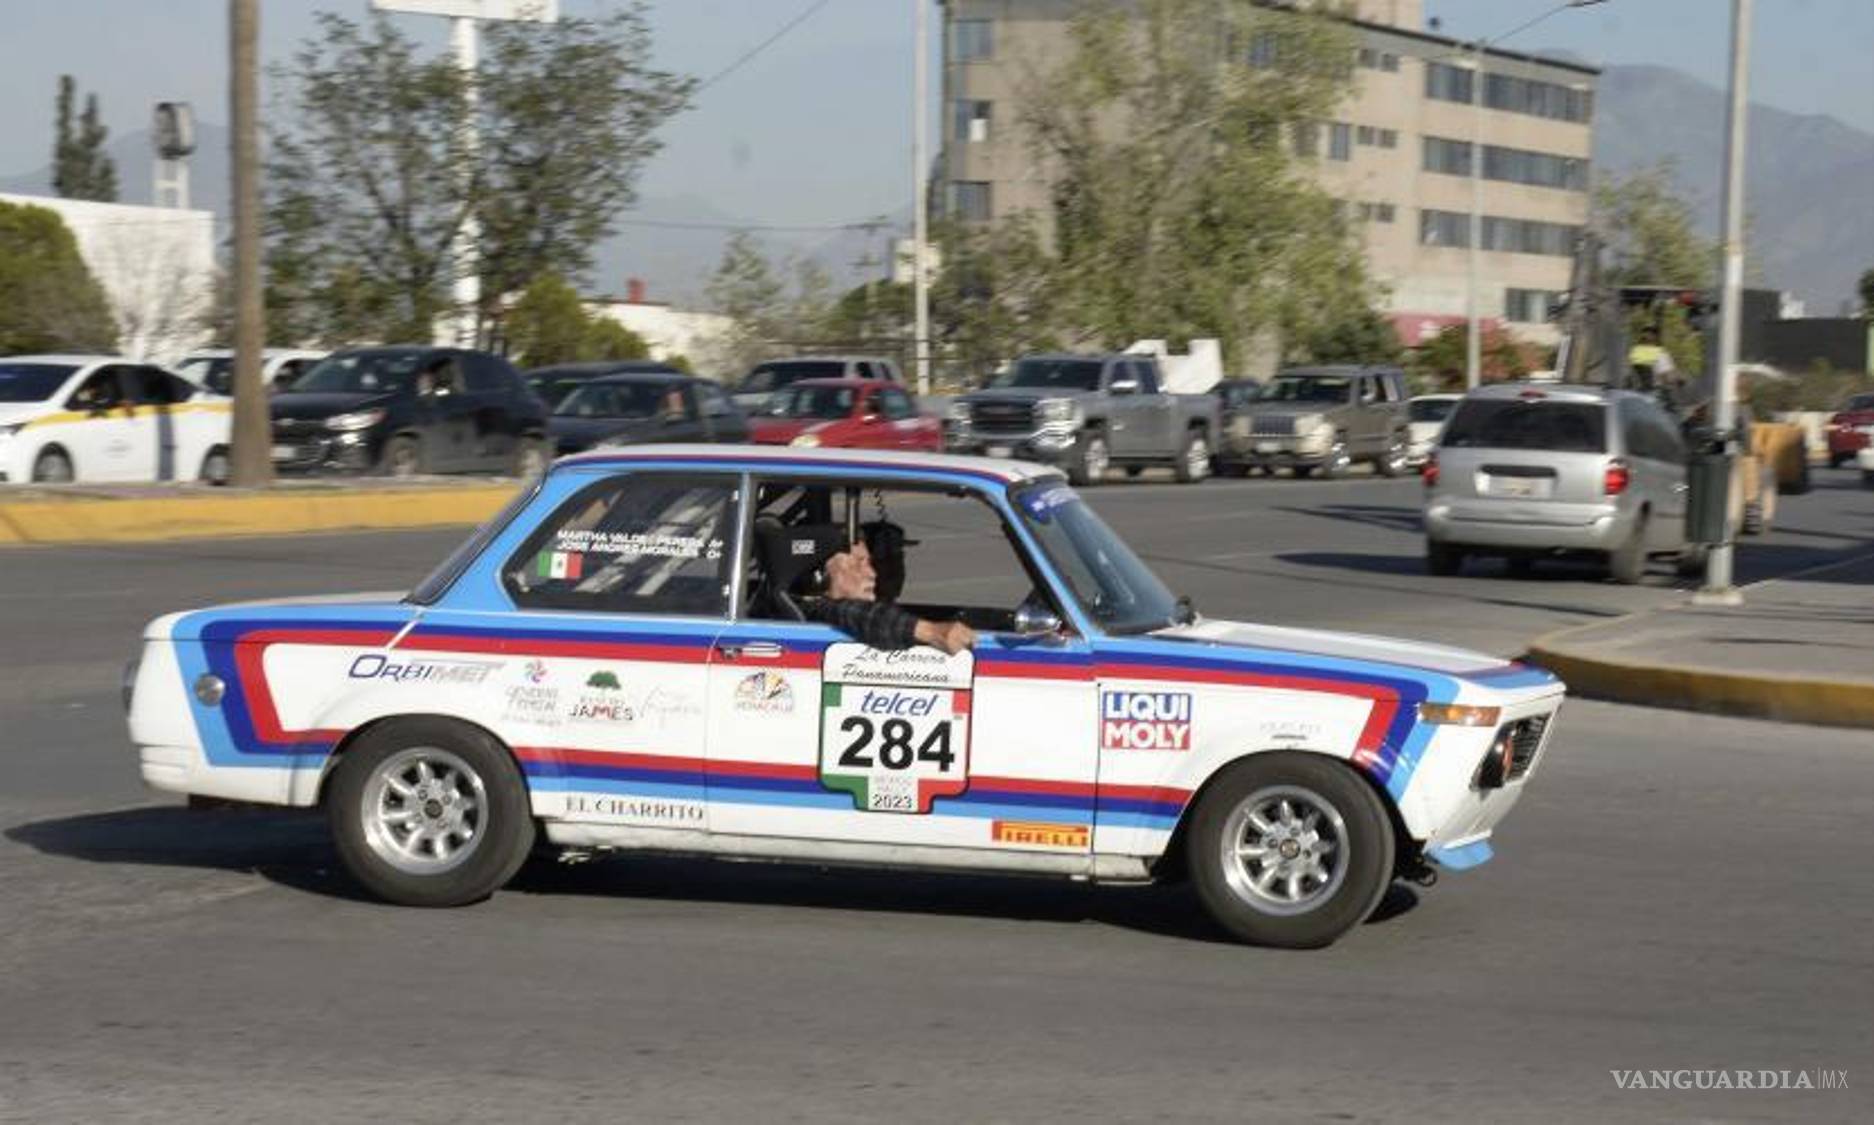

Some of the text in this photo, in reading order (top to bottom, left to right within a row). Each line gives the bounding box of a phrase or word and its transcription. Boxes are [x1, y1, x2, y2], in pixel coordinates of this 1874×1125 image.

[557, 530, 607, 543] MARTHA
[842, 663, 950, 682] Panamericana
[569, 704, 633, 720] JAMES
[861, 690, 939, 716] telcel
[1105, 694, 1189, 719] LIQUI
[838, 716, 955, 772] 284
[1104, 723, 1189, 748] MOLY
[566, 798, 704, 821] EL CHARRITO
[872, 794, 912, 809] 2023
[992, 821, 1088, 846] PIRELLI
